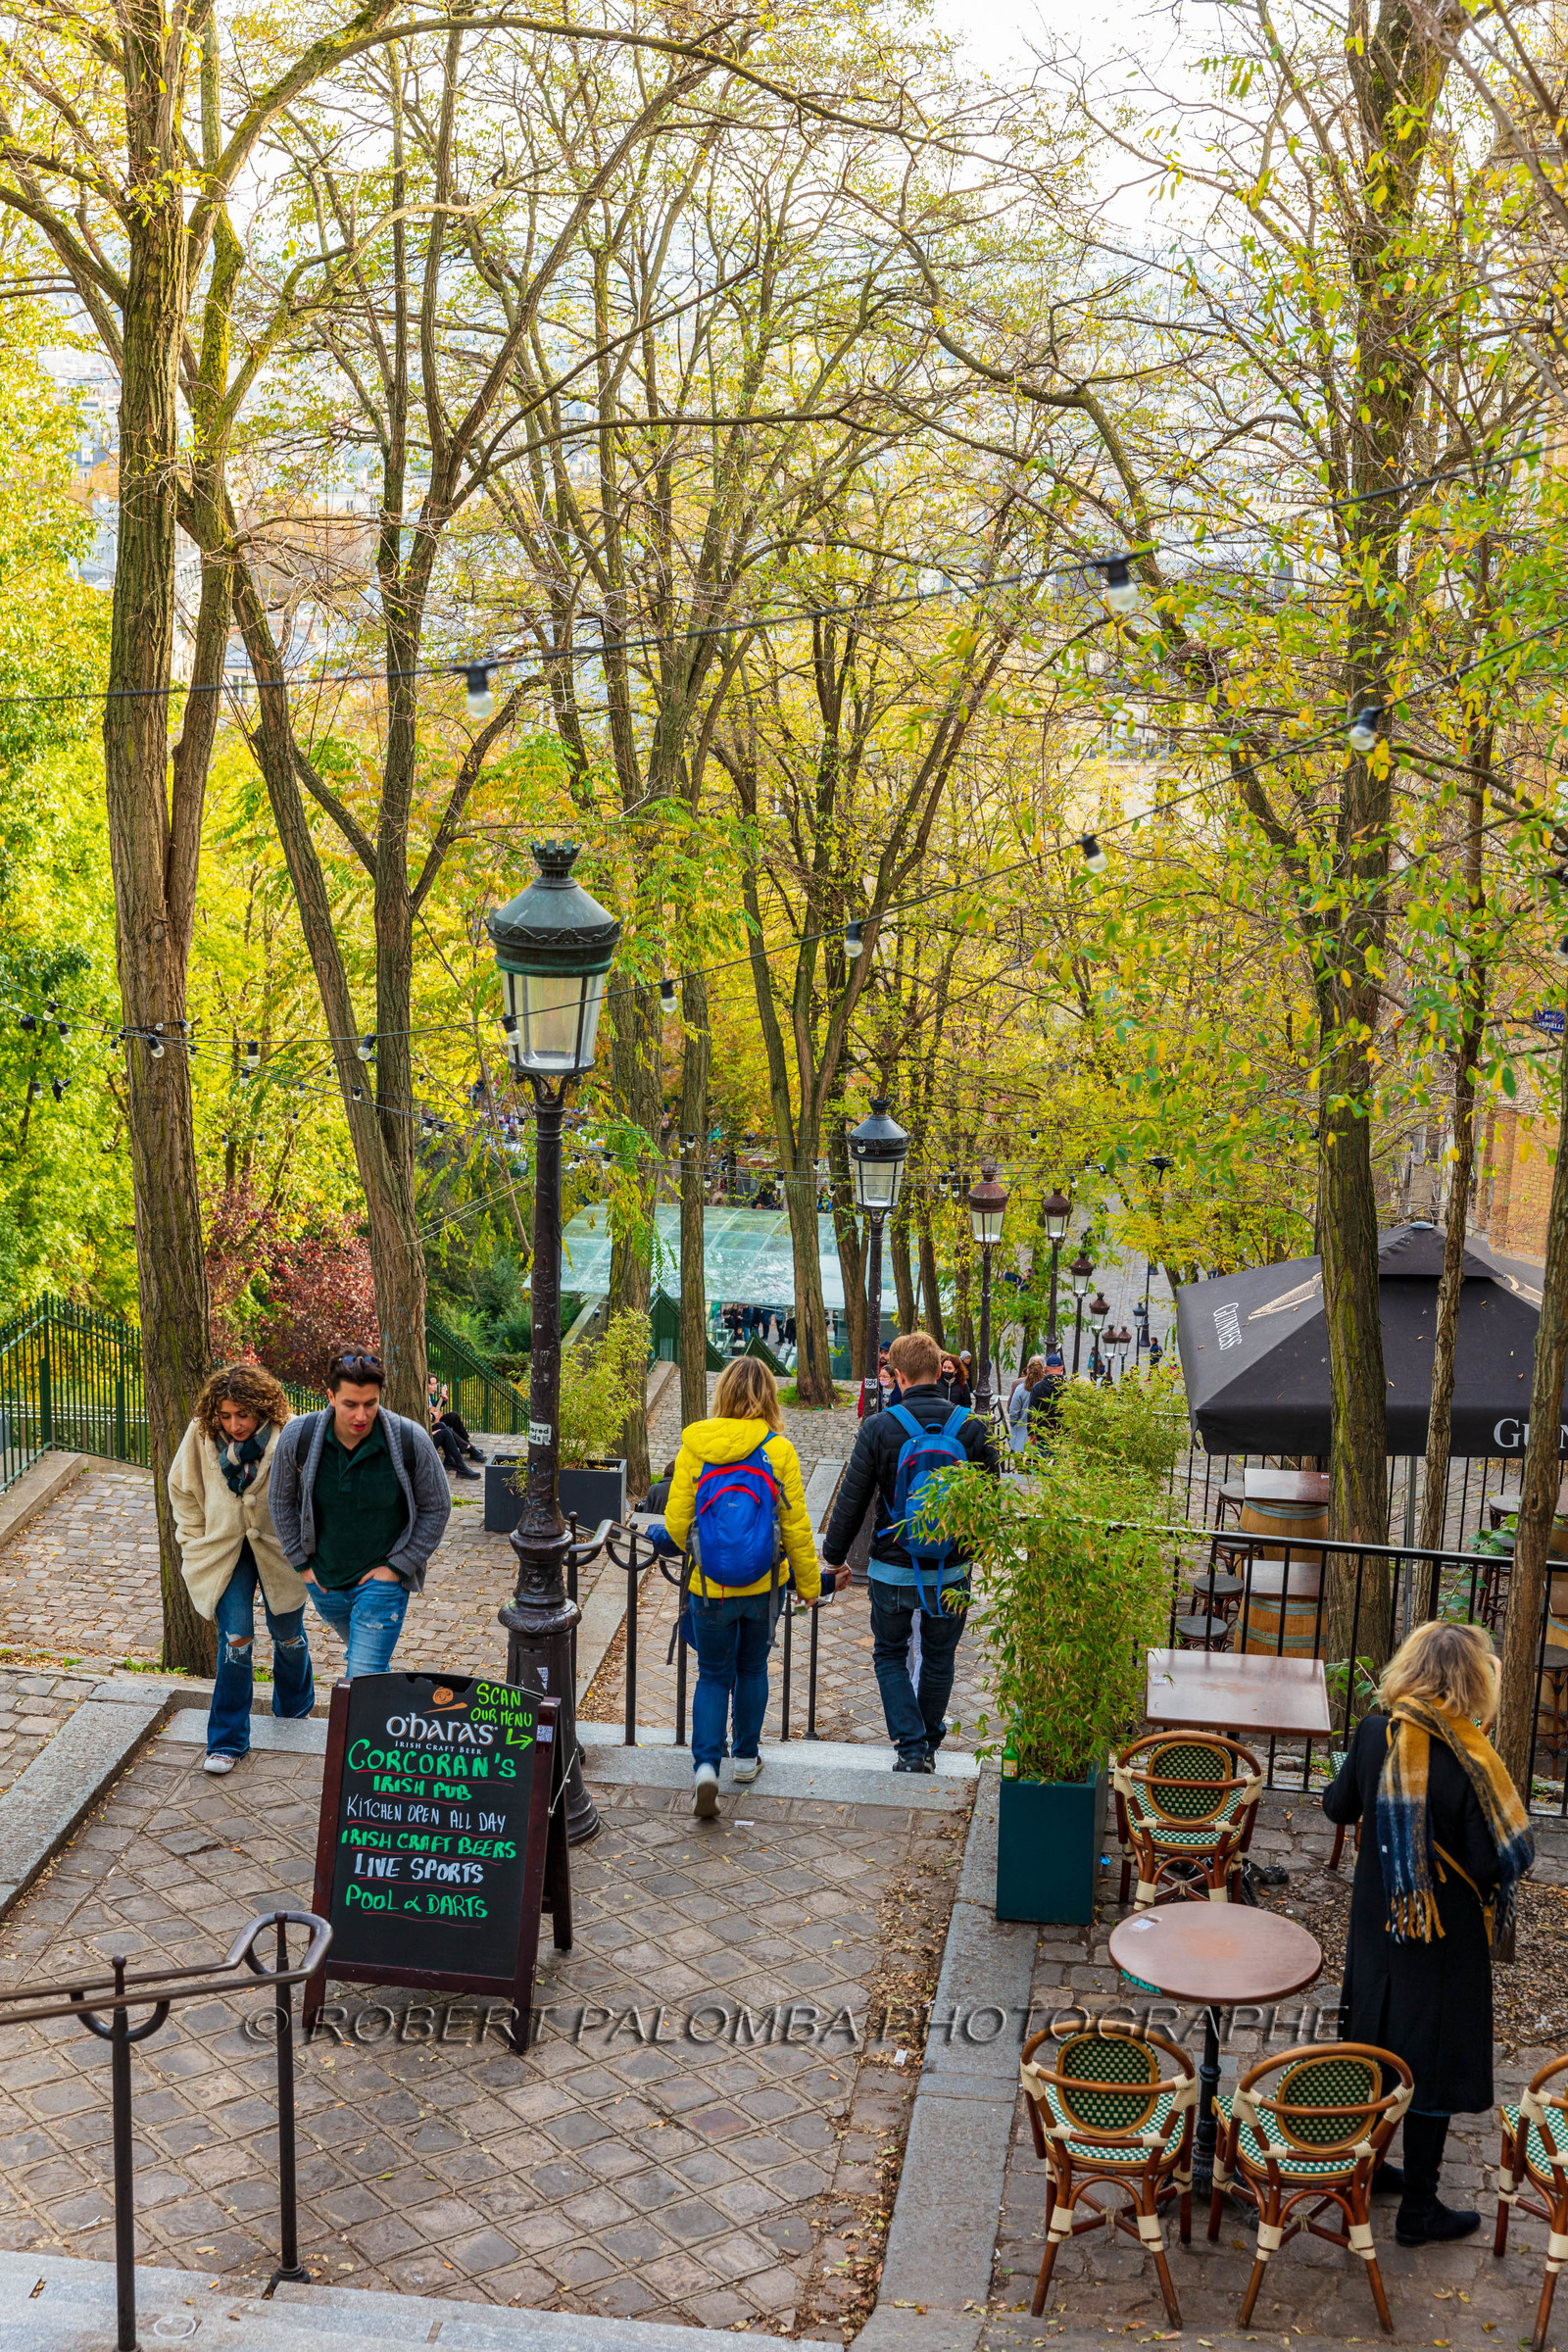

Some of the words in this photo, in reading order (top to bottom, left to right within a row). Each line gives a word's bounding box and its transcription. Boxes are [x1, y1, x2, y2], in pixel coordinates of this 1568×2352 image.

[1213, 1302, 1243, 1350] GUINNESS
[476, 1682, 521, 1709] SCAN
[470, 1707, 498, 1724] OUR
[500, 1709, 533, 1728] MENU
[348, 1739, 516, 1778] CORCORAN'S
[395, 1740, 421, 1749] IRISH
[425, 1743, 456, 1752] CRAFT
[460, 1746, 482, 1755] BEER
[372, 1775, 425, 1796] IRISH
[433, 1784, 472, 1800] PUB
[407, 1804, 440, 1825] OPEN
[450, 1810, 471, 1830] ALL
[478, 1812, 507, 1834] DAY
[341, 1829, 391, 1849] IRISH
[397, 1833, 454, 1853] CRAFT
[458, 1837, 516, 1859] BEERS
[354, 1853, 404, 1878] LIVE
[410, 1857, 484, 1884] SPORTS
[345, 1884, 400, 1910] POOL
[425, 1893, 488, 1918] DARTS
